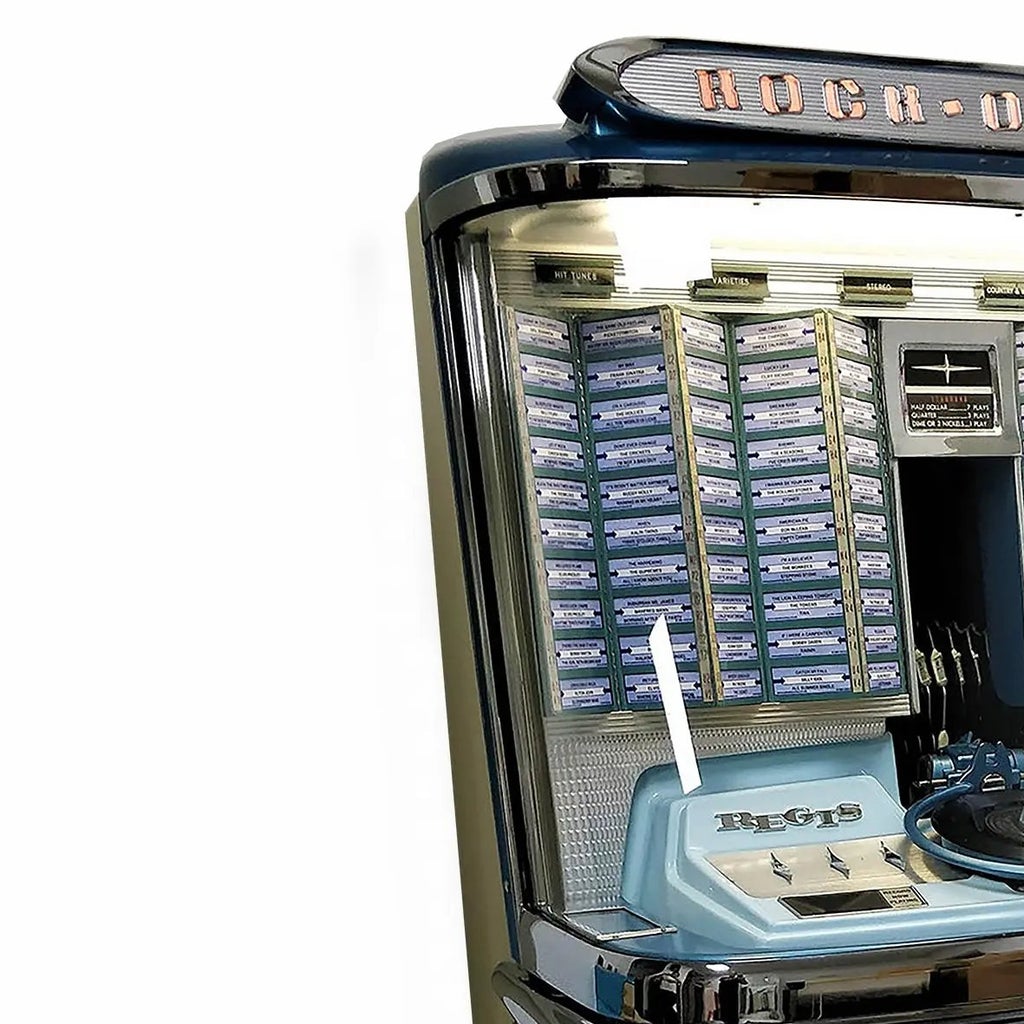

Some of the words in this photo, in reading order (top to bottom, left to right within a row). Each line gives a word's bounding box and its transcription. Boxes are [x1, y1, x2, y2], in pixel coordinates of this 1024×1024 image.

[554, 270, 568, 280] HIT
[712, 276, 749, 286] VARIETIES
[866, 282, 892, 291] STEREO
[986, 286, 1013, 297] COUNTRY
[714, 802, 863, 834] REGIS
